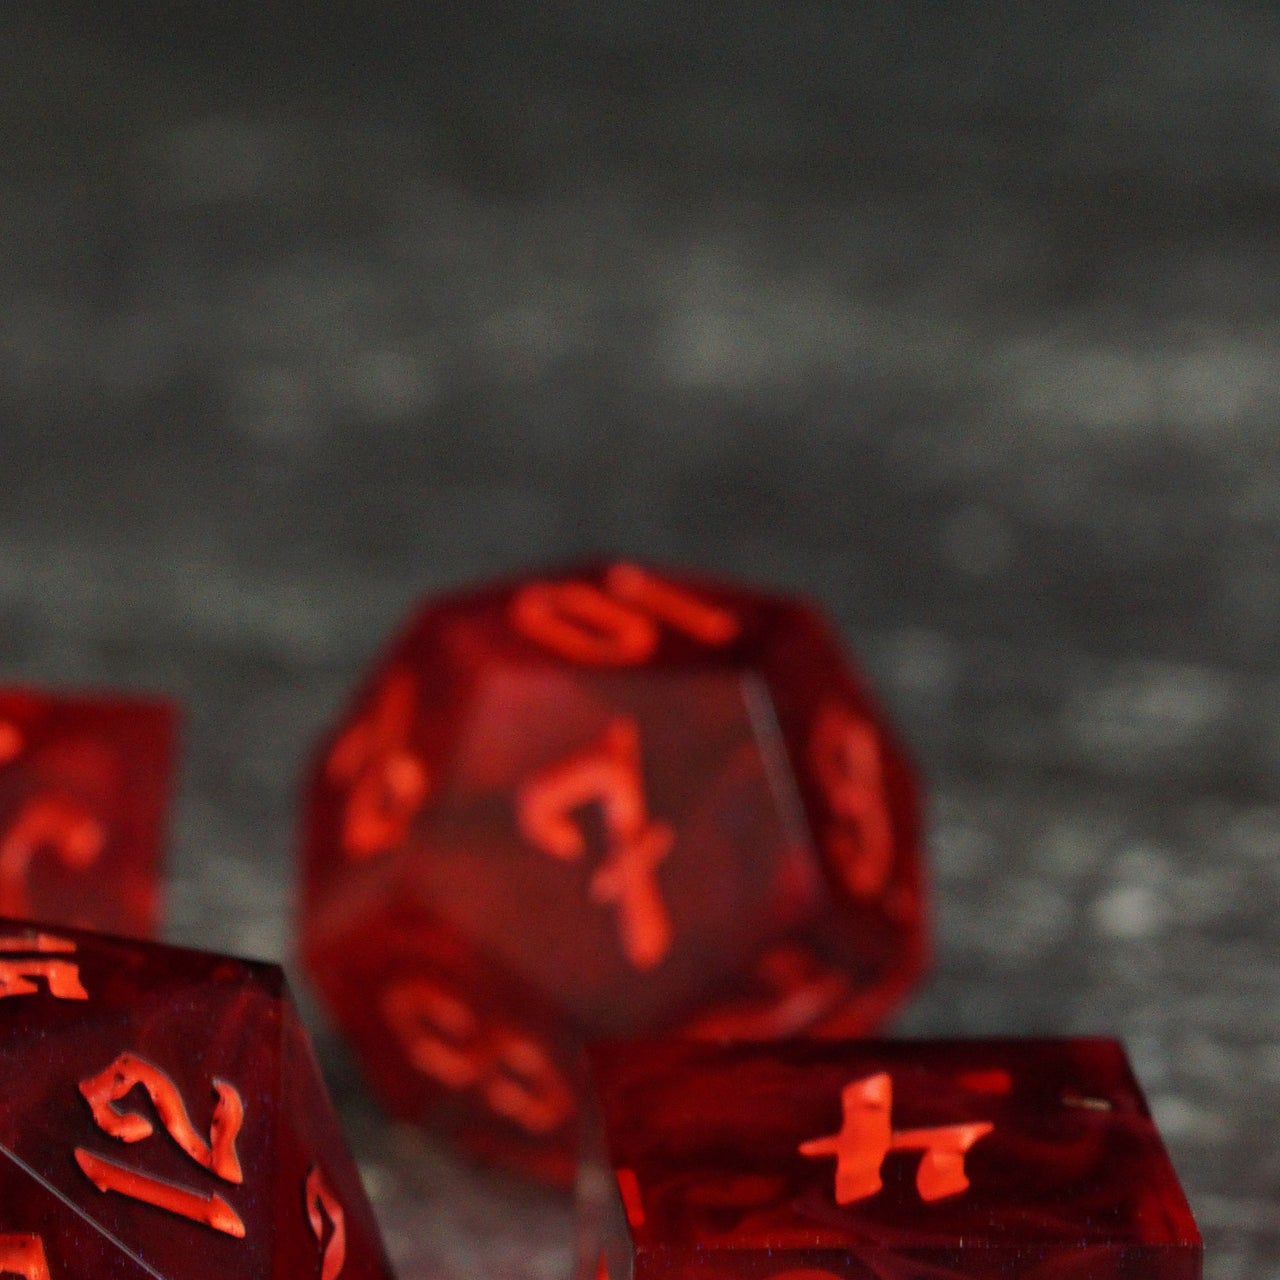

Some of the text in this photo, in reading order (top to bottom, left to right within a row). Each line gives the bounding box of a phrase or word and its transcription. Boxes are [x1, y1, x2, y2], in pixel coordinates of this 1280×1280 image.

[515, 716, 675, 970] 7
[73, 1052, 246, 1239] 12
[797, 1072, 995, 1205] 4
